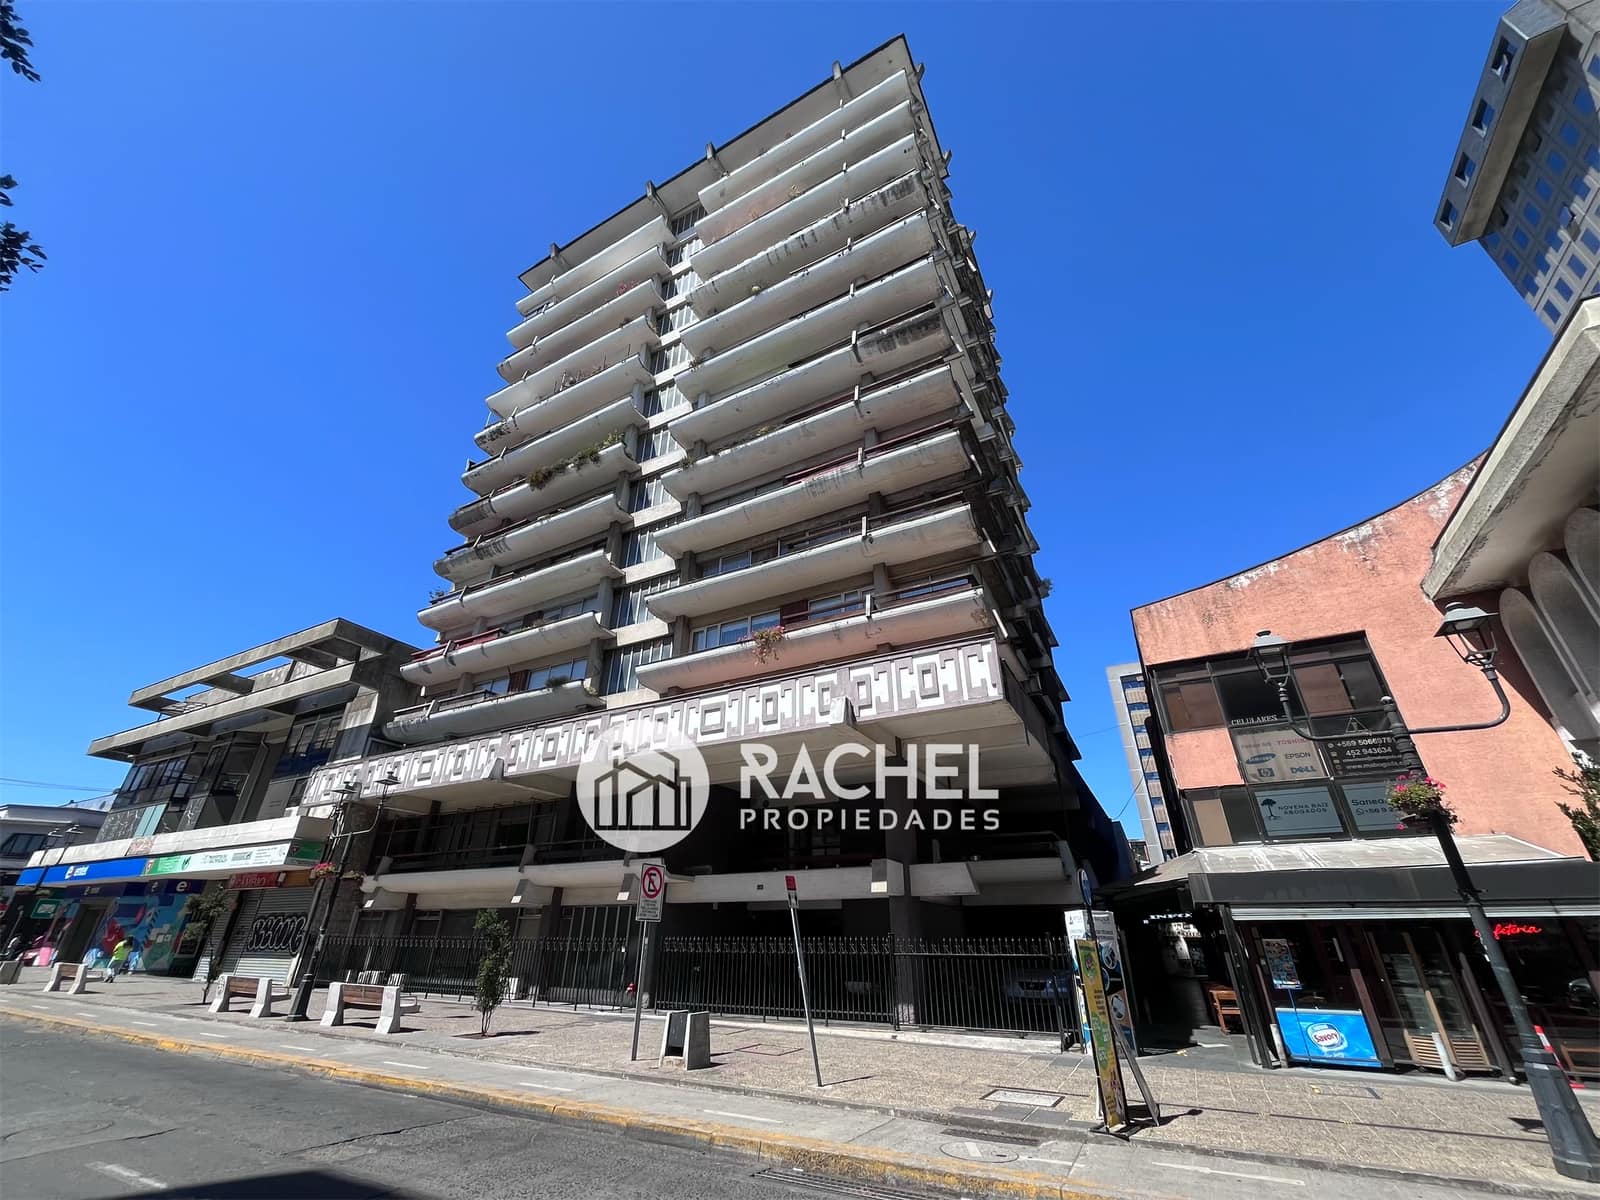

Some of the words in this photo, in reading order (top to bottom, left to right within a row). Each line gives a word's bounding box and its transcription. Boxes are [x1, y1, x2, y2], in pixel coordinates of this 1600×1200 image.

[1285, 752, 1311, 760] EPSON
[1291, 766, 1316, 774] DELL
[1313, 1033, 1338, 1042] Savory
